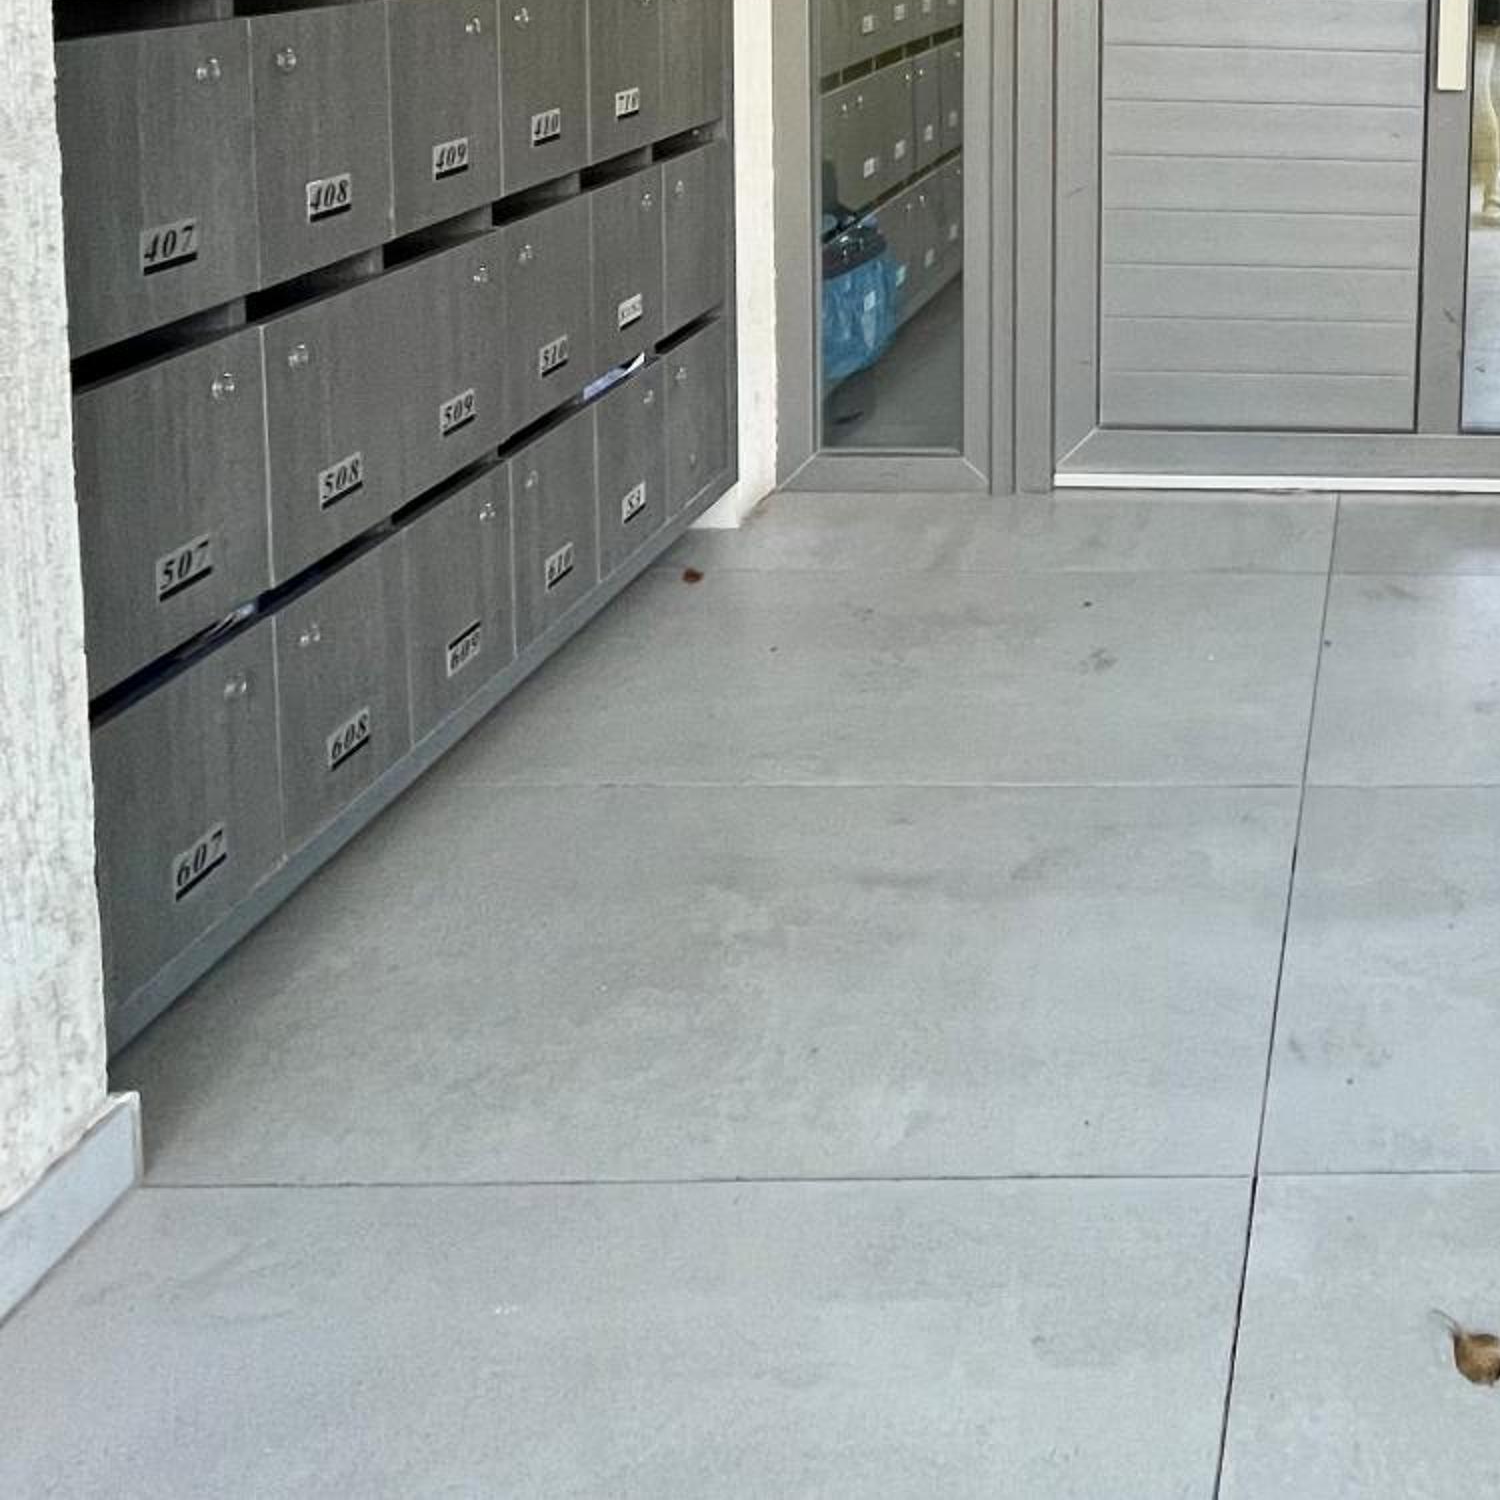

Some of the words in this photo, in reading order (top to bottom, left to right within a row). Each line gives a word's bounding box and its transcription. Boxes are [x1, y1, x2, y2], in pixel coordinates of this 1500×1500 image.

[436, 144, 467, 170] 409
[310, 180, 348, 211] 408
[144, 225, 194, 262] 407
[443, 394, 474, 423] 509
[322, 458, 360, 499] 508
[332, 712, 368, 760] 608
[177, 828, 223, 887] 607
